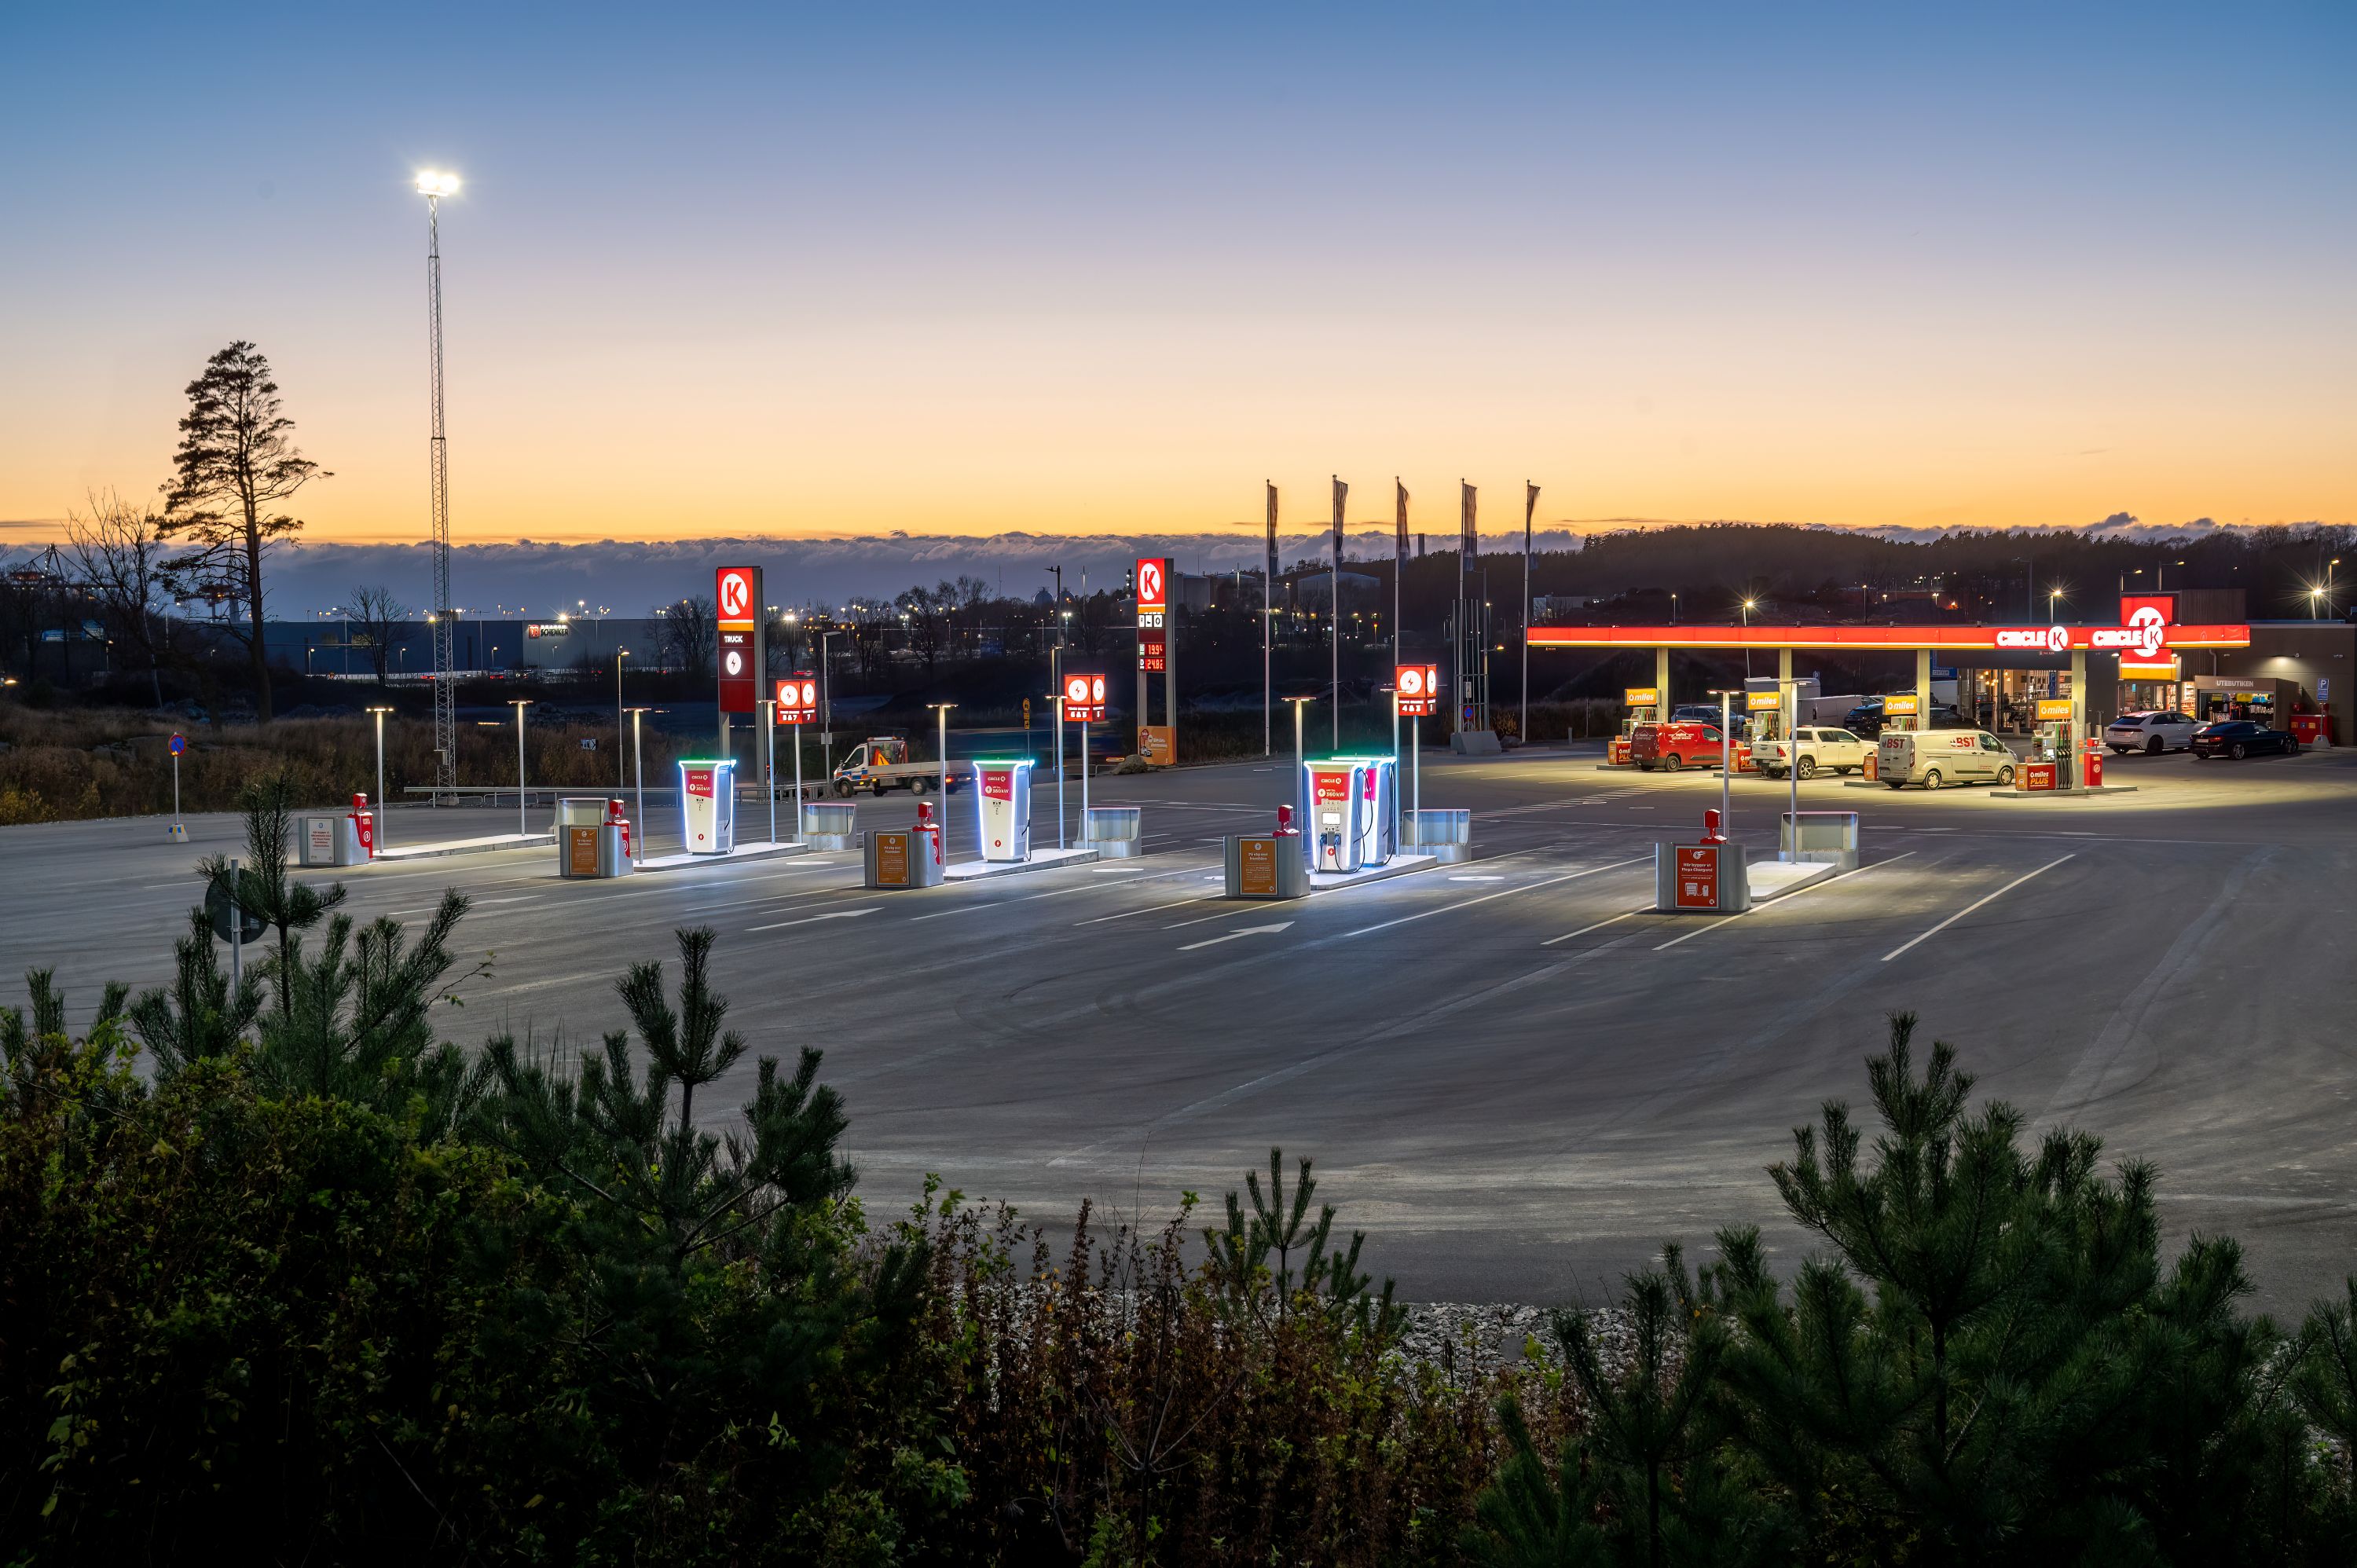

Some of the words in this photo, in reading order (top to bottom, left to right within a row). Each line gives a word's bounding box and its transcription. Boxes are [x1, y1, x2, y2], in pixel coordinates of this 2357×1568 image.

[1142, 566, 1160, 599] K
[725, 579, 746, 614] K
[1996, 631, 2046, 646] CIRCLE
[2051, 628, 2068, 650] K
[2092, 631, 2143, 647] CIRCLE
[2146, 628, 2161, 650] K
[2321, 680, 2327, 688] P
[2047, 705, 2069, 714] miles
[1887, 738, 1906, 749] BST
[1956, 737, 1975, 747] BST
